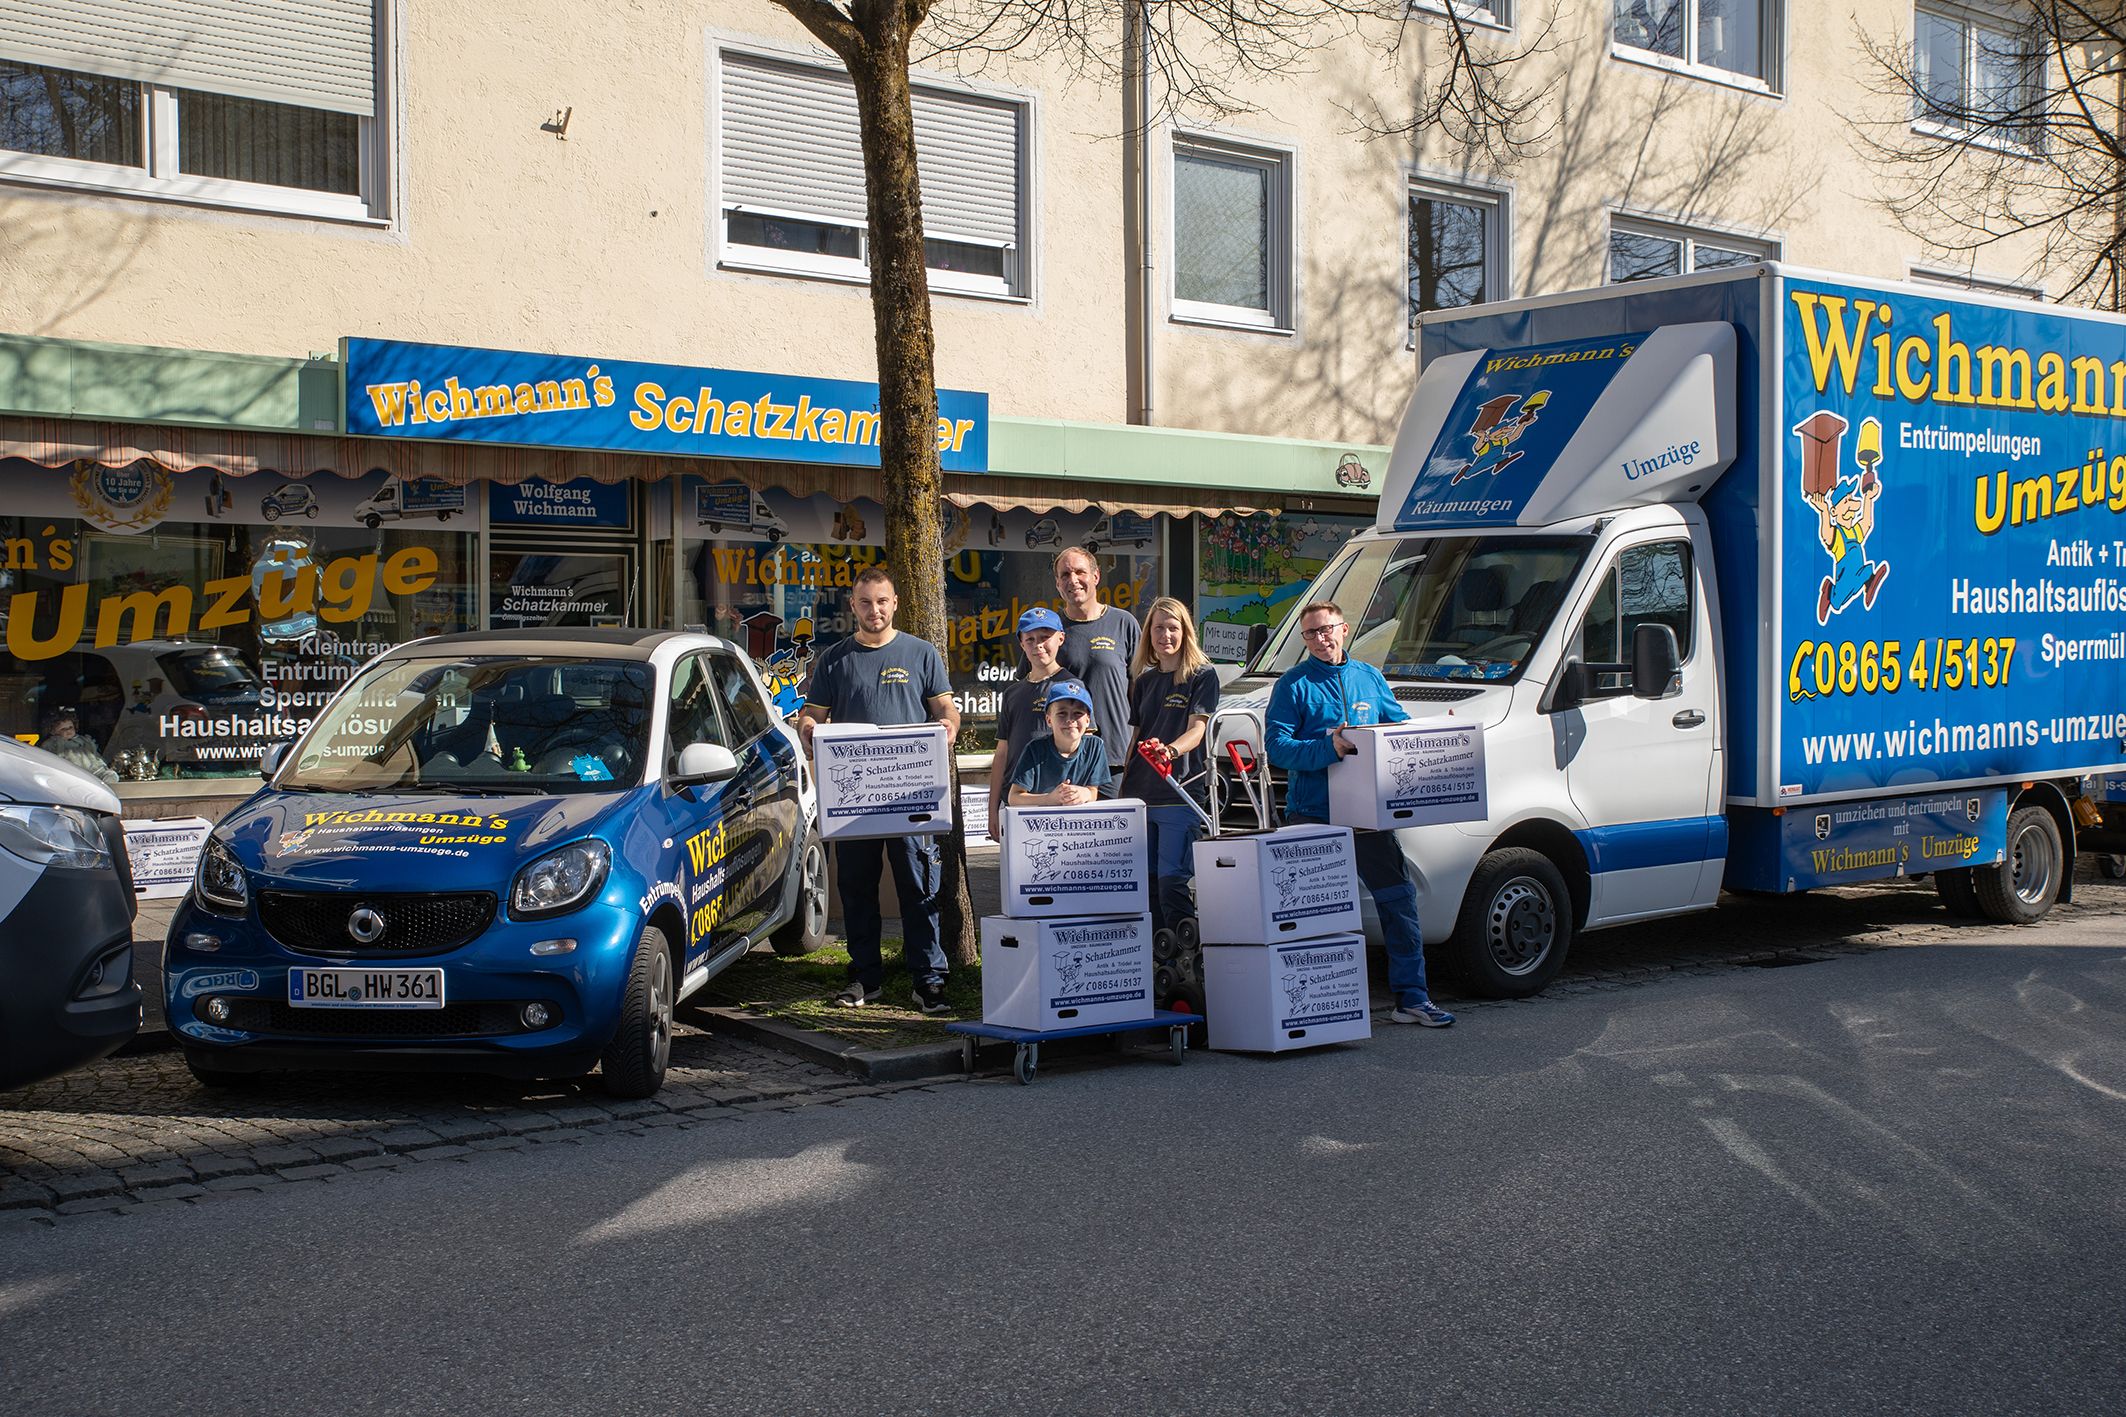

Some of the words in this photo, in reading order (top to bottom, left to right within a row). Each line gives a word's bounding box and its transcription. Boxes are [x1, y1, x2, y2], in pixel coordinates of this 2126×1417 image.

[1485, 343, 1635, 374] Wichmann's
[366, 364, 615, 427] Wichmann's
[629, 381, 975, 453] Schatzkamer
[1899, 421, 2041, 460] Entrümpelungen
[1621, 440, 1701, 481] Umzüge
[105, 478, 116, 486] 10
[118, 479, 142, 488] Jahre
[519, 483, 592, 504] Wolfgang
[513, 500, 597, 518] Wichmann
[1411, 497, 1513, 517] Räumungen
[2046, 539, 2093, 567] Antik
[511, 585, 574, 597] Wichmann's
[6, 546, 438, 662] Umzüge
[502, 597, 608, 613] Schatzkammer
[1205, 626, 1220, 638] Mit
[1222, 631, 1236, 640] uns
[1238, 631, 1248, 640] du
[1204, 644, 1220, 653] und
[1222, 645, 1235, 655] mit
[1236, 646, 1247, 657] Sp
[977, 660, 1017, 682] Gebr
[829, 739, 929, 759] Wichmann's
[1388, 732, 1471, 752] Wichmann's
[866, 759, 933, 776] Schatzkammer
[1419, 751, 1474, 769] Schatzkammer
[865, 780, 934, 790] Haushaltsauflösungen
[1426, 782, 1475, 794] 08654/5137
[875, 790, 934, 802] 08654/5137
[1390, 795, 1475, 807] www.wichmanns-umzuege.de
[831, 804, 935, 815] www.wichmanns-umzuege.de
[1835, 805, 1885, 824] umziehen
[1888, 802, 1906, 817] und
[1908, 796, 1962, 817] entrümpeln
[304, 809, 509, 830] Wichmann's
[1024, 815, 1128, 832] Wichmann's
[317, 825, 444, 835] Haushaltsauflösungen
[1893, 821, 1909, 836] mit
[419, 834, 507, 846] Umzüge
[1062, 835, 1133, 852] Schatzkammer
[304, 844, 470, 858] www.wichmanns-umzuege.de
[1812, 841, 1909, 874] Wichmann's
[1921, 833, 1980, 859] Umzüge
[159, 867, 194, 876] 08654/51
[1070, 869, 1133, 880] 08654/5137
[1298, 859, 1347, 878] Schatzkammer
[1025, 883, 1133, 893] www.wichmanns-umzuege.de
[1307, 890, 1349, 904] 08654/5137
[1053, 924, 1138, 945] Wichmann's
[1085, 944, 1142, 963] Schatzkammer
[1084, 968, 1142, 978] Haushaltsauflösungen
[1309, 966, 1358, 985] Schatzkammer
[307, 973, 347, 998] BGL
[365, 974, 392, 998] HW
[396, 974, 438, 999] 361
[1092, 977, 1142, 991] 08654/5137
[1054, 992, 1142, 1006] www.wichmanns-umzuege.de
[1317, 998, 1360, 1012] 08654/5137
